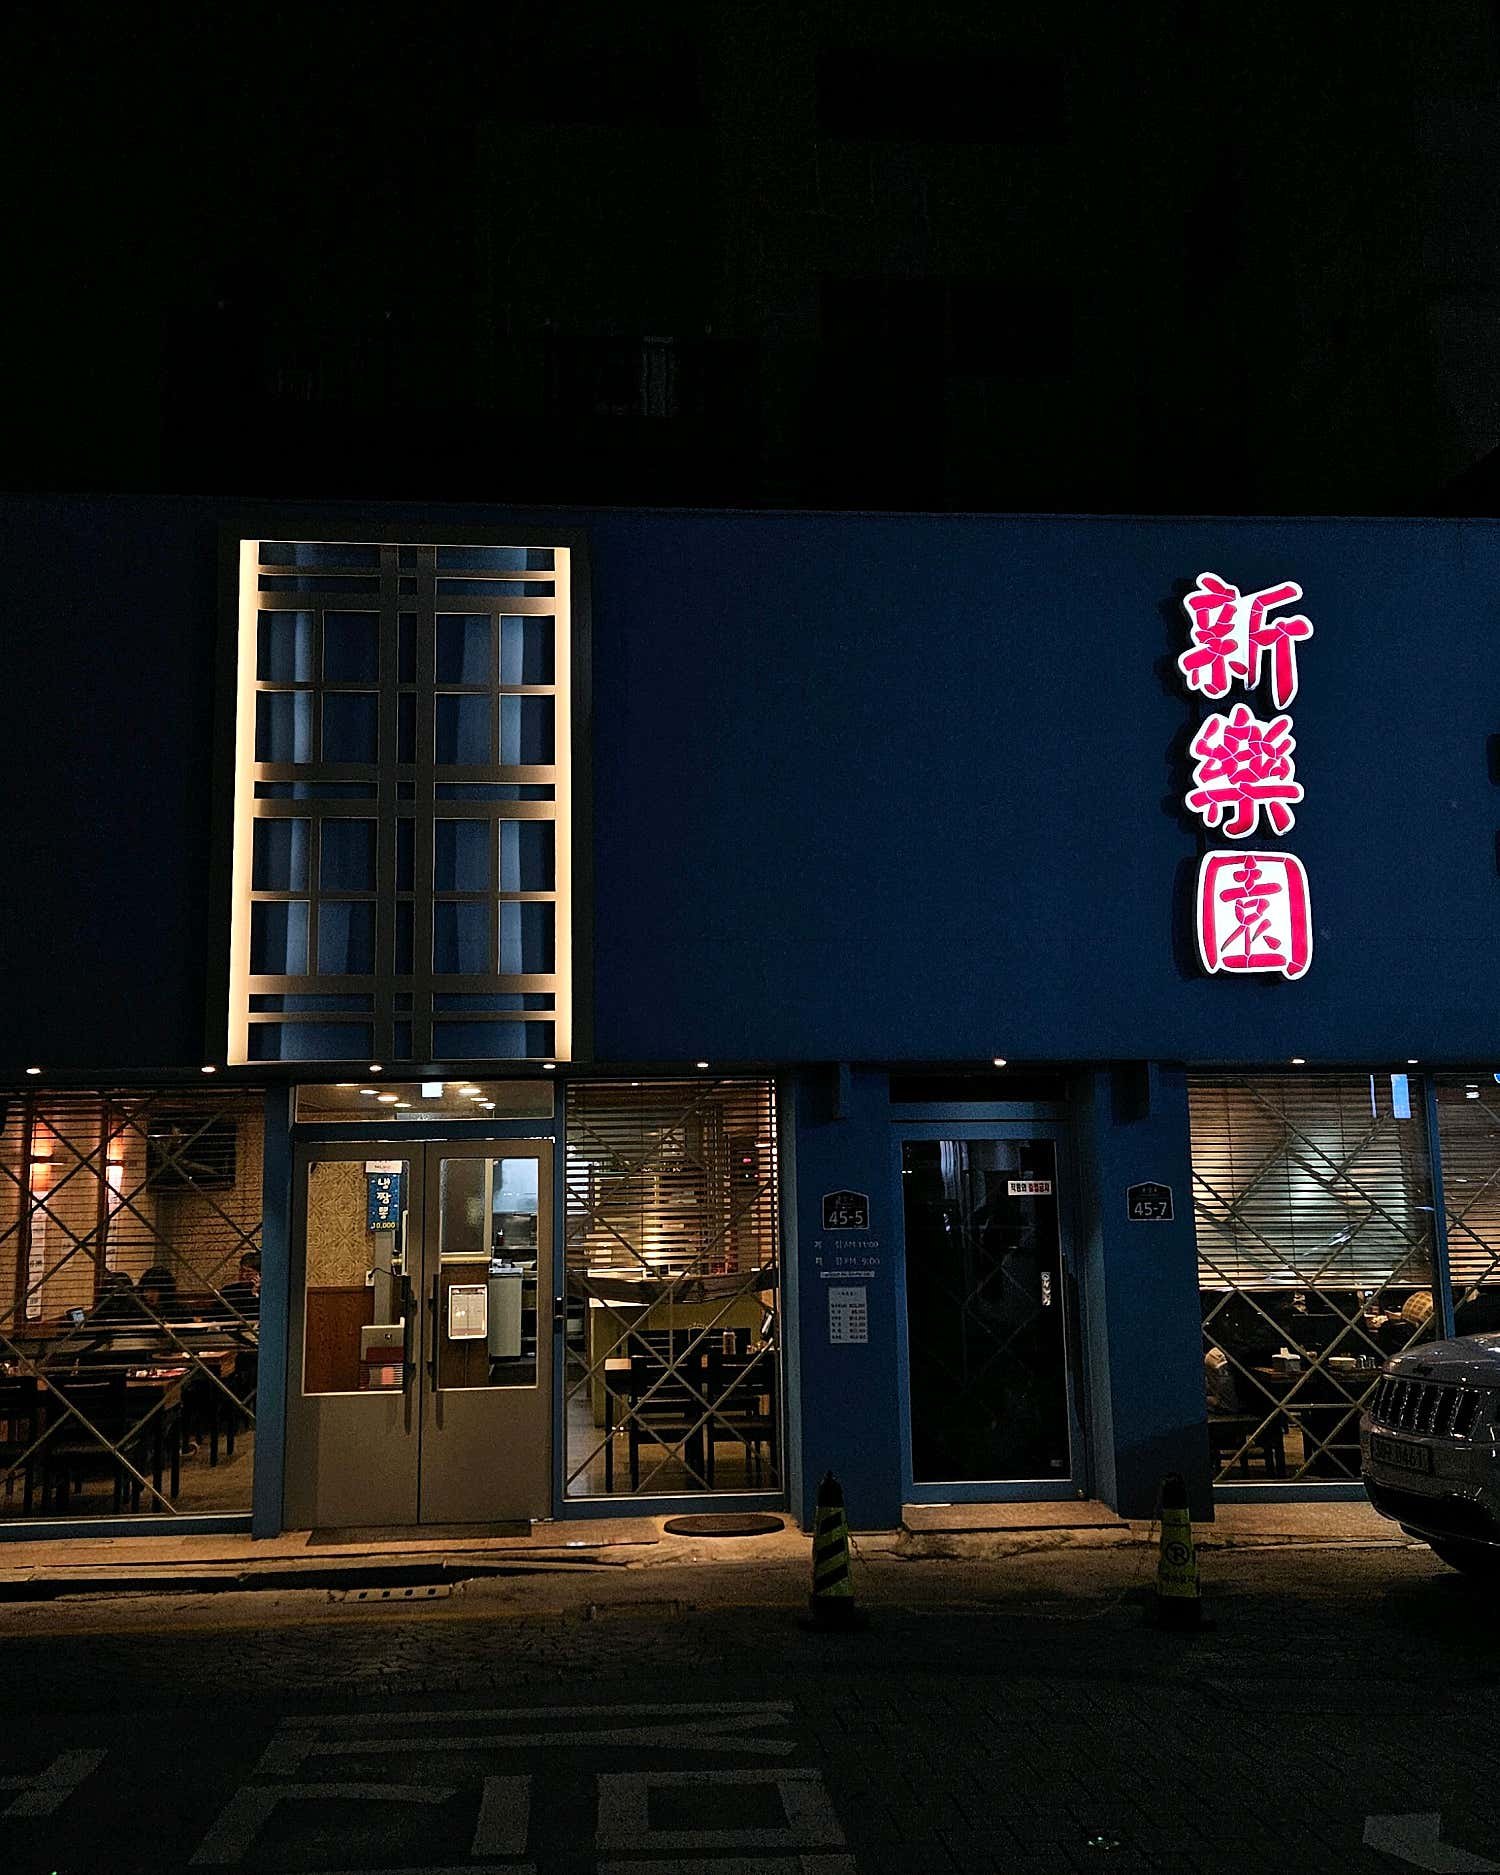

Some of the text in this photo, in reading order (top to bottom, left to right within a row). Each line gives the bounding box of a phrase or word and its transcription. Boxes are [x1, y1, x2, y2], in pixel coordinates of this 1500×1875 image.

[1178, 572, 1314, 981] 新樂園
[1134, 1201, 1167, 1216] 45-7
[828, 1210, 864, 1225] 45-5
